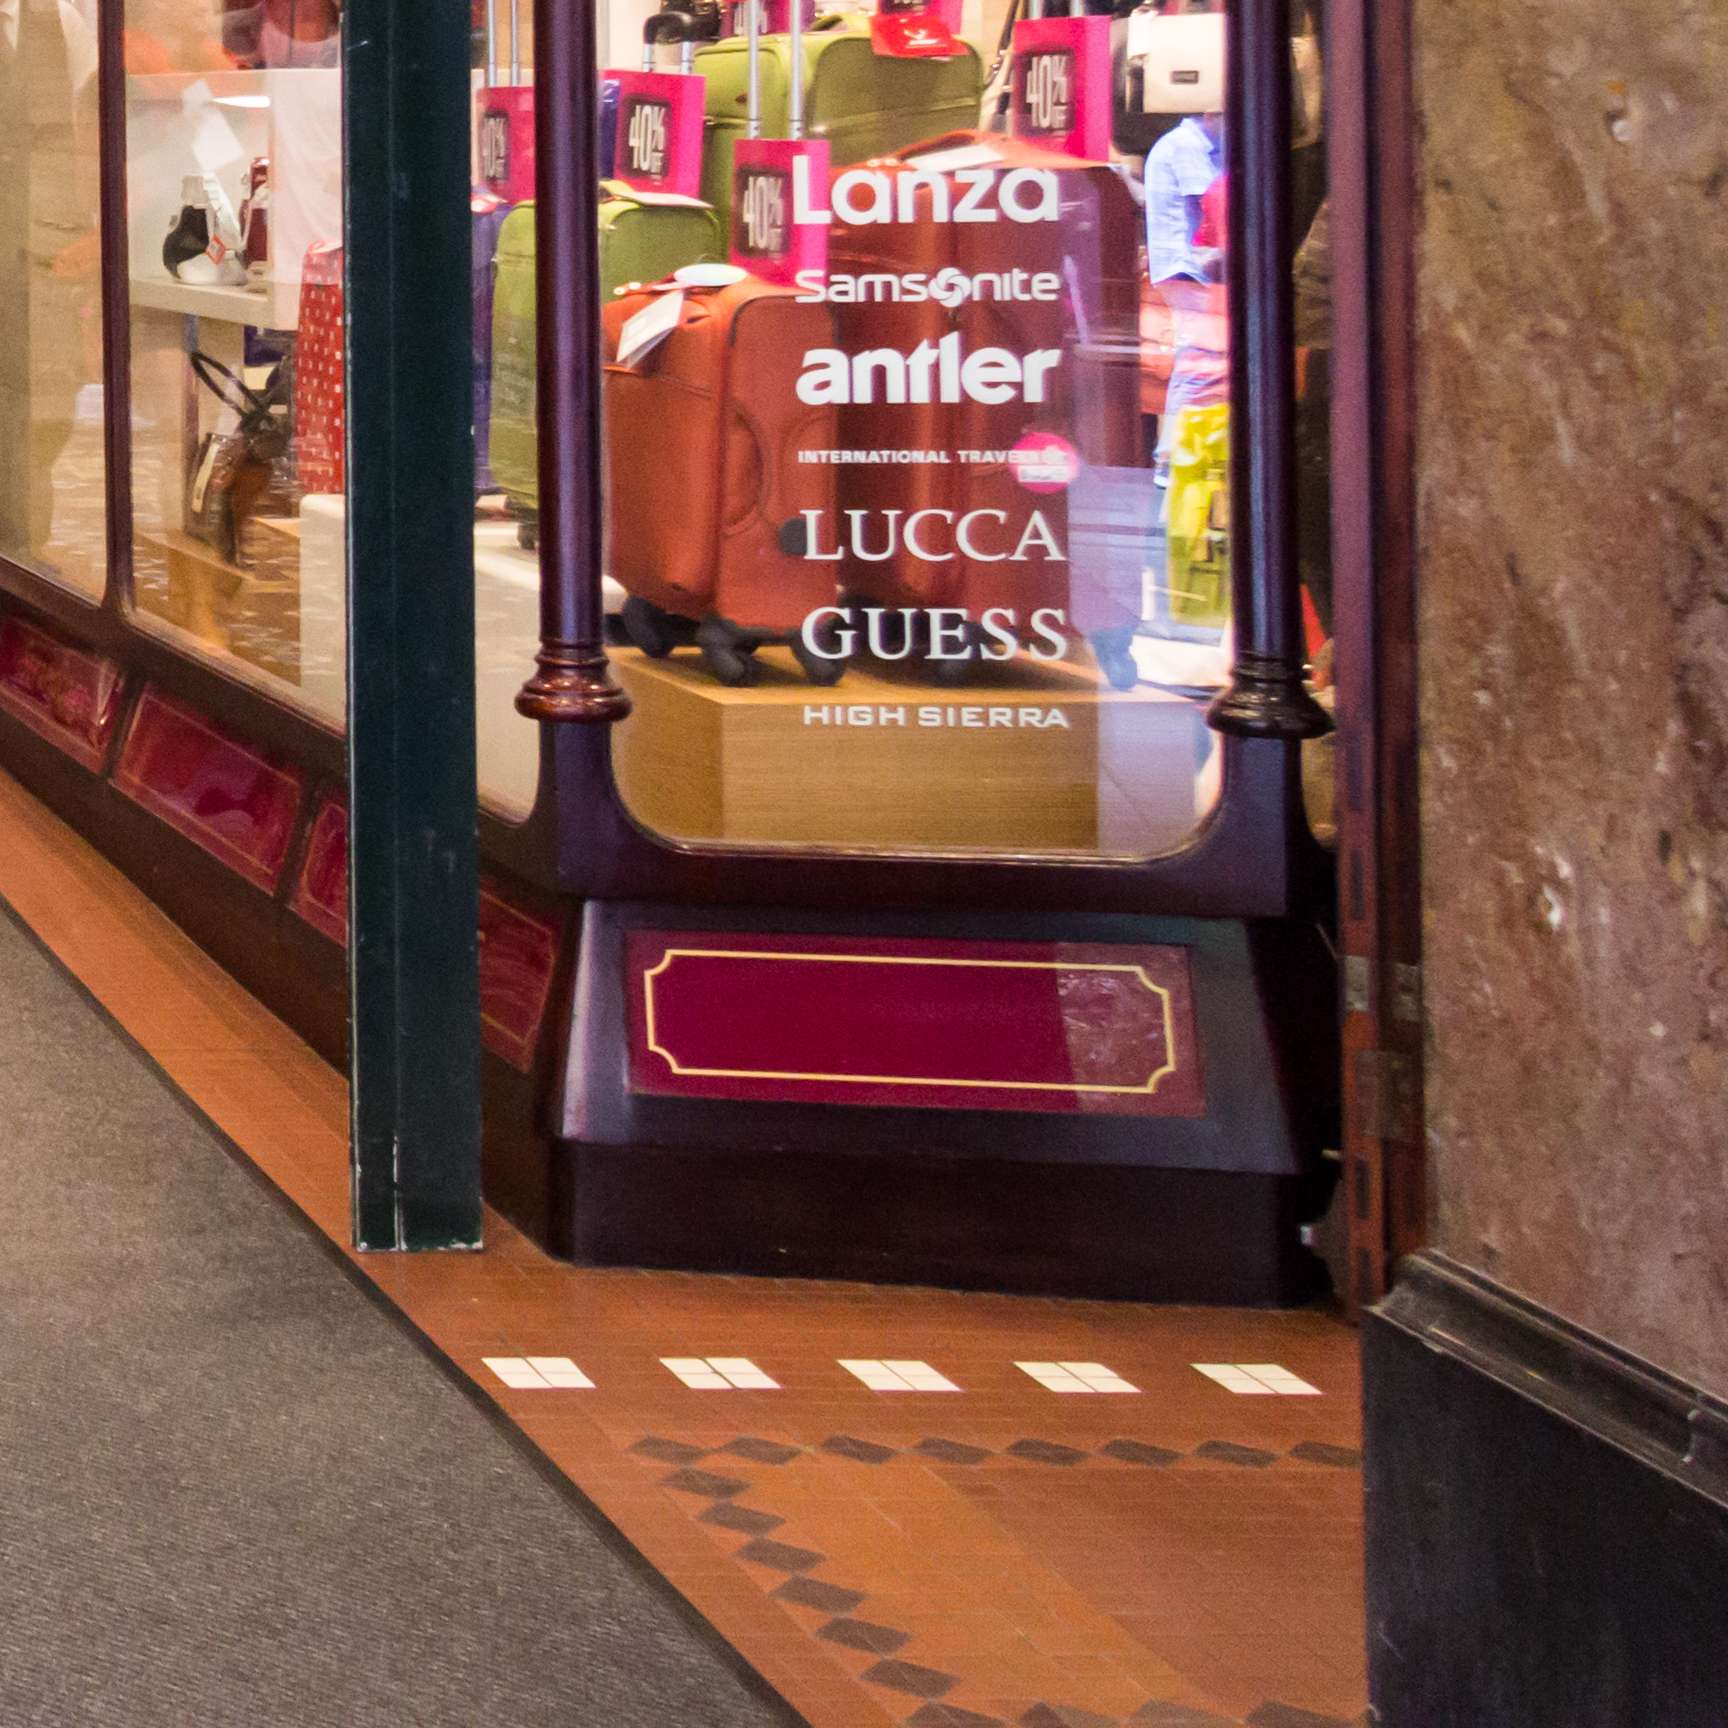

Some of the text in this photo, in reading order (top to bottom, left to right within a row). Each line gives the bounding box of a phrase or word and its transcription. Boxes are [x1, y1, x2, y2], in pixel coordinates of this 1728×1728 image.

[1026, 55, 1068, 128] 40%
[629, 105, 665, 170] 40%
[792, 155, 1060, 225] Lanza
[795, 267, 1061, 307] Samsonite
[796, 331, 1062, 405] antler
[798, 449, 950, 464] INTERNATIONAL
[799, 509, 1067, 561] LUCCA
[801, 607, 1067, 661] GUESS
[803, 704, 1070, 728] HIGH SIERRA
